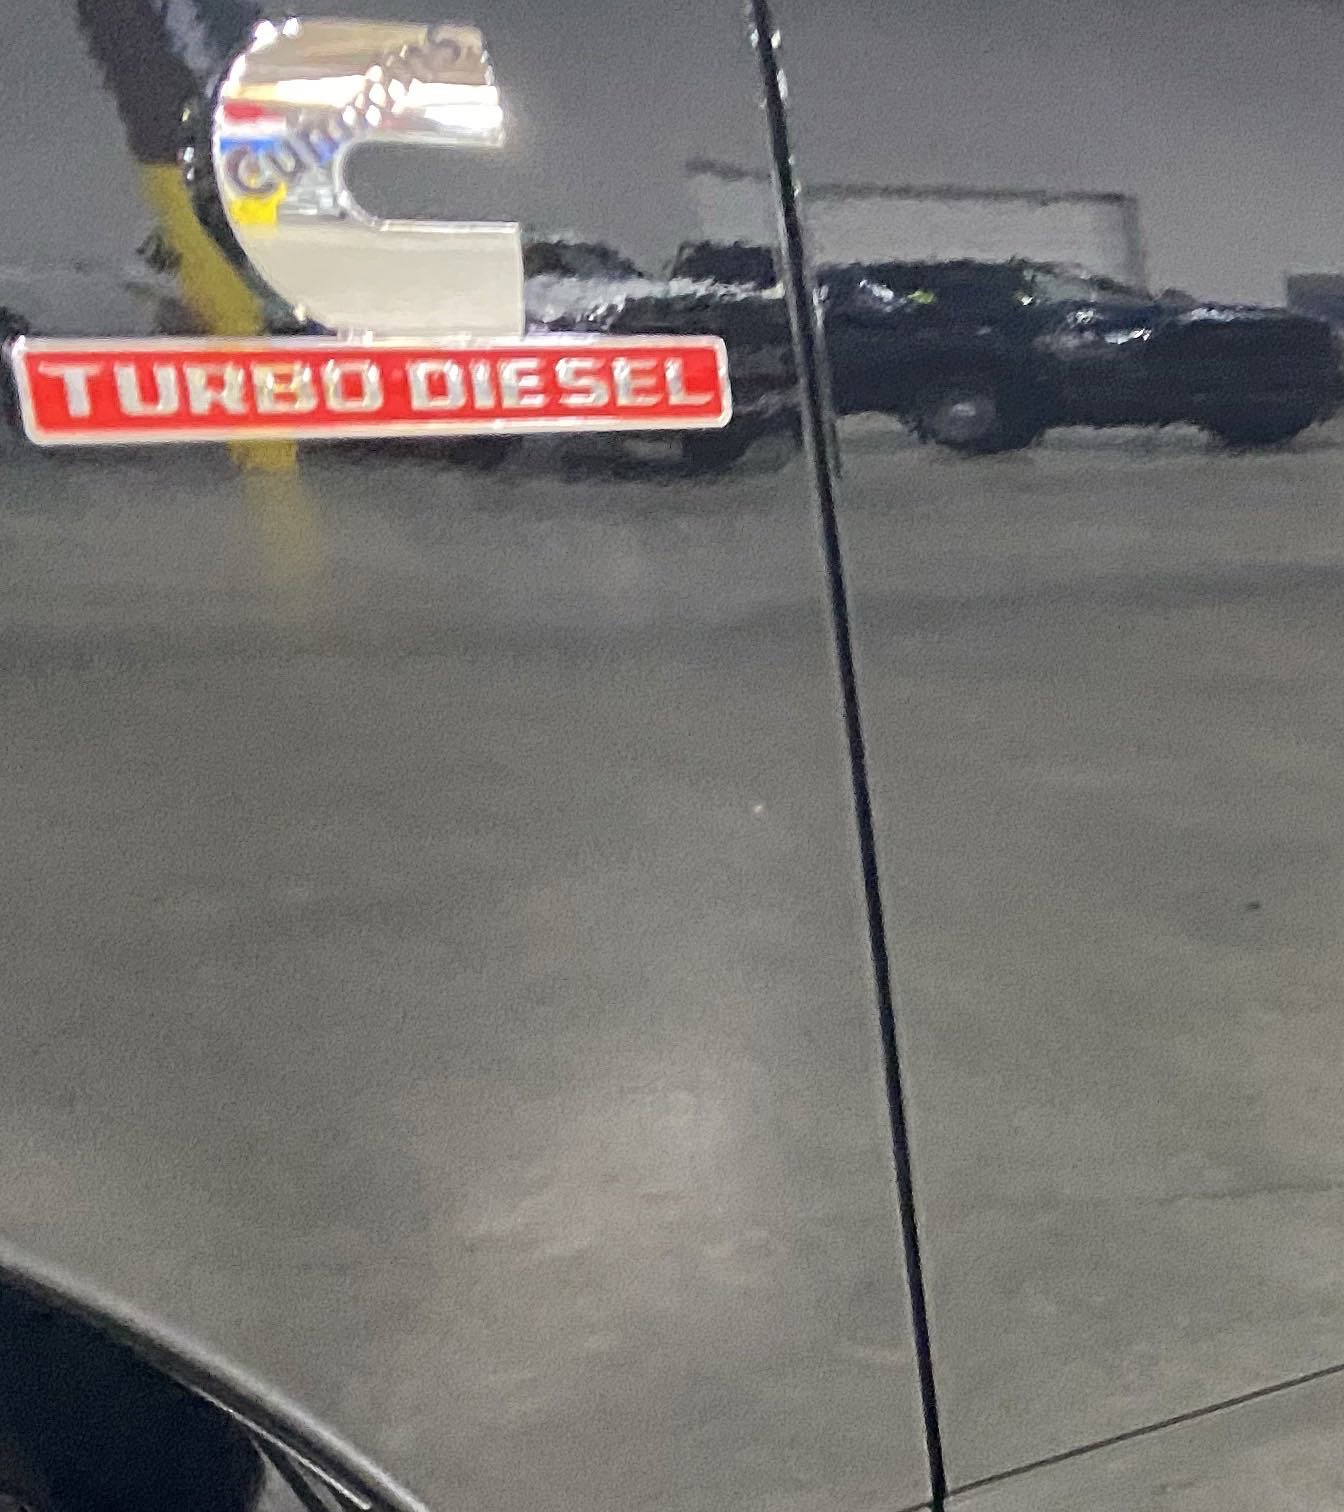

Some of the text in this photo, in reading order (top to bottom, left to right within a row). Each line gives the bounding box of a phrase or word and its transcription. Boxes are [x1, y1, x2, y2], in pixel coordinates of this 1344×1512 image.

[224, 35, 464, 194] Cums
[37, 355, 714, 419] TURBO DIESEL
